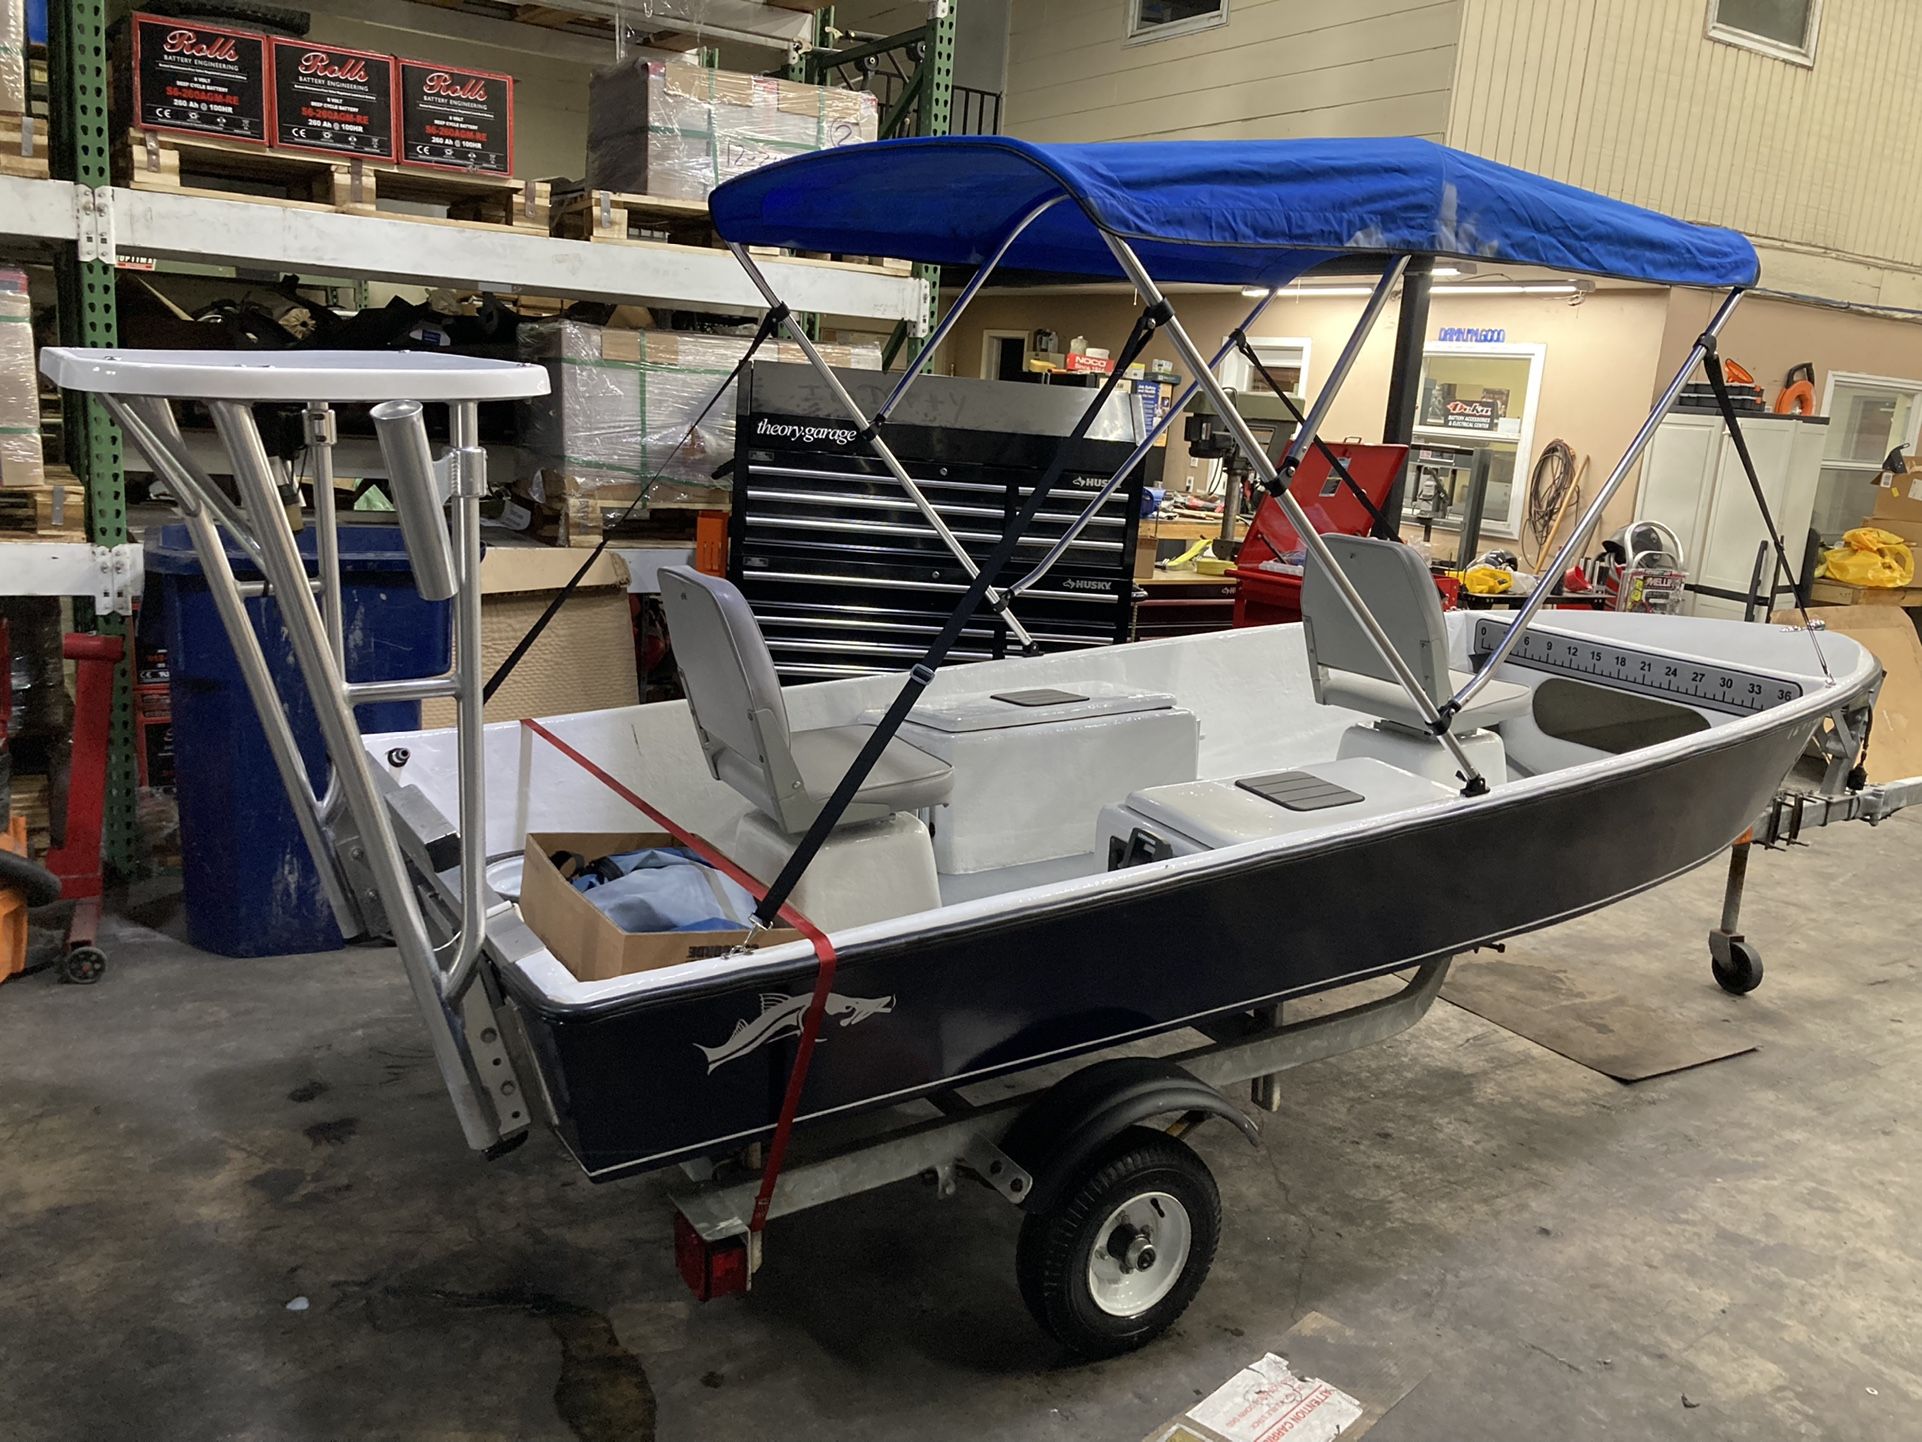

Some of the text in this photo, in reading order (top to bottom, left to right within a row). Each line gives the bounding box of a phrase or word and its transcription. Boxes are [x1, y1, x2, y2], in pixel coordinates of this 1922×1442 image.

[163, 30, 239, 62] Rolls
[164, 54, 239, 71] BATTERY ENGINEERING
[298, 52, 368, 82] Rolls
[298, 76, 325, 85] BATTERY
[327, 81, 369, 92] ENGINEERING
[423, 72, 488, 101] Rolls
[173, 99, 187, 107] 260
[210, 104, 233, 113] 100HR
[423, 95, 488, 110] BATTERY ENGINEERING
[341, 124, 363, 132] 100HR
[431, 136, 444, 144] 260
[462, 141, 482, 149] 100HR
[1075, 356, 1106, 367] NOCO
[1446, 401, 1492, 416] Deka
[757, 418, 857, 445] theory.garage
[1076, 580, 1112, 590] HUSKY
[1481, 627, 1792, 701] 0 6 9 12 15 18 21 24 27 30 33 36
[1293, 1387, 1332, 1423] ATTENTION
